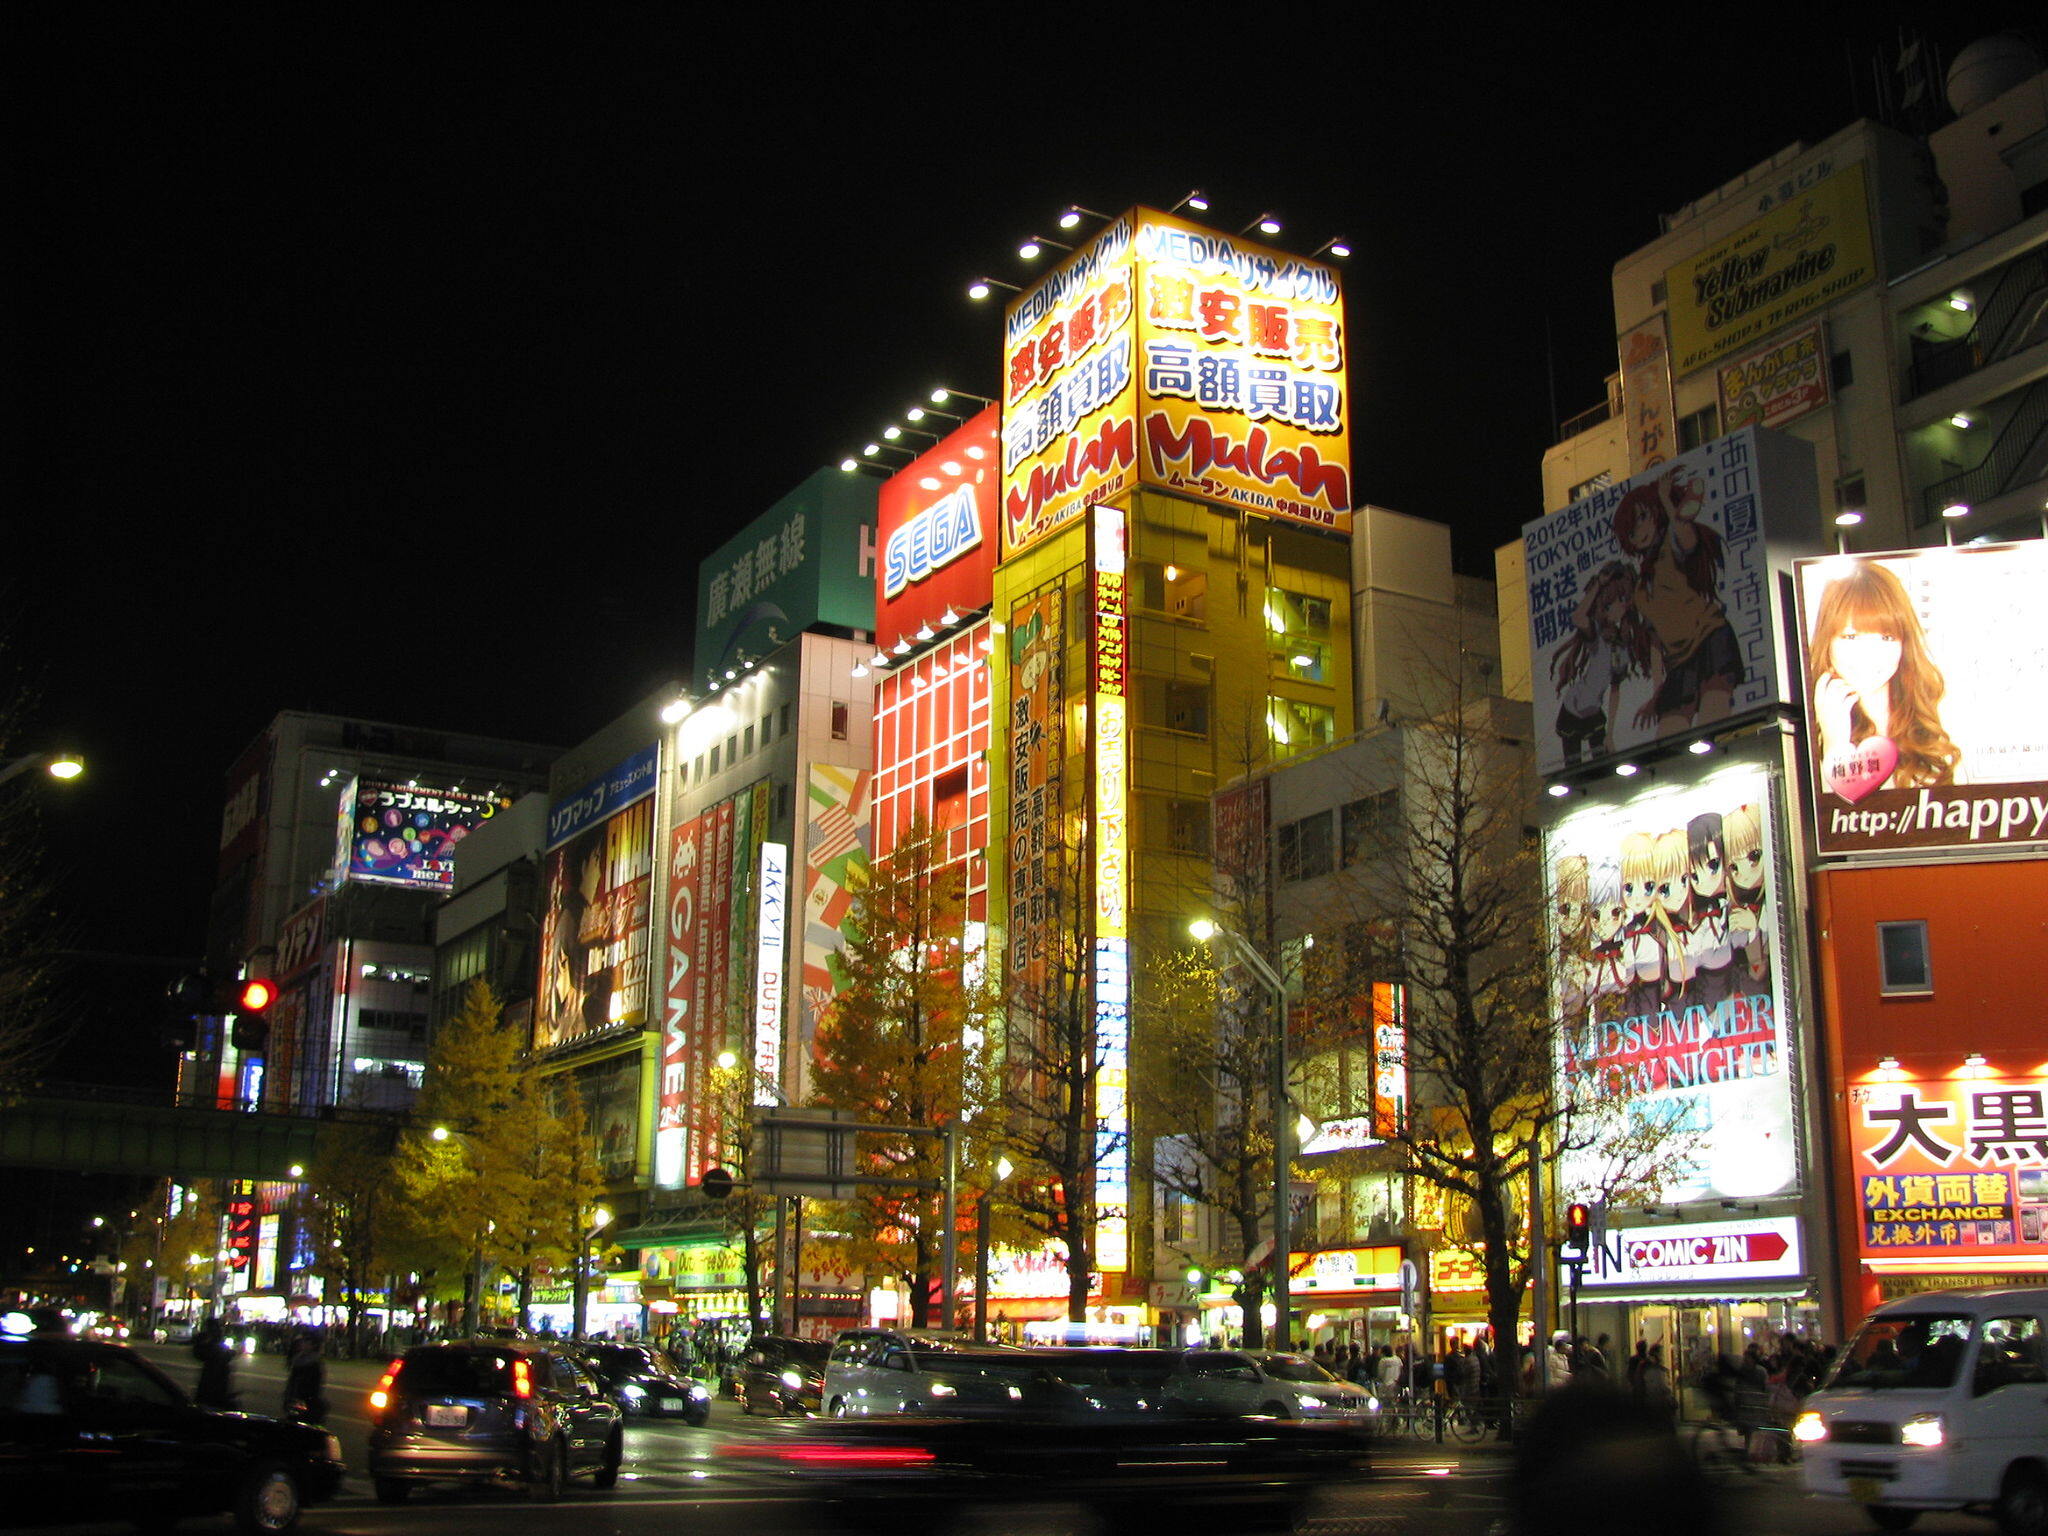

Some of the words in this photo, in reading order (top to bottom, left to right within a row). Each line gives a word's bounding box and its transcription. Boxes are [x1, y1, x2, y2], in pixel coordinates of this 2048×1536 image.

[1693, 246, 1769, 303] Yellow
[1708, 243, 1836, 330] Submarine
[1010, 279, 1129, 400] 激安販売
[1149, 271, 1336, 366] 激安販売
[1007, 340, 1127, 470] 高額買取
[1147, 344, 1337, 428] 高額買取
[1006, 419, 1135, 546] Mulan
[1145, 412, 1349, 511] Mulan
[1168, 472, 1229, 496] ムーラン
[1231, 487, 1274, 508] AKIBA
[885, 486, 979, 595] SEGA
[1017, 514, 1054, 546] ムーラン
[1054, 500, 1082, 526] AKIBA
[1526, 478, 1631, 552] 2012年1月より
[1528, 531, 1585, 575] TOKYO
[1586, 514, 1614, 544] MX
[1098, 572, 1122, 589] DVD
[1530, 563, 1578, 615] 放送
[1534, 600, 1577, 649] 開始
[379, 790, 474, 815] ラブメルシー
[551, 781, 607, 838] ソフマップ
[1830, 790, 2048, 841] http://happy
[604, 800, 651, 894] FINAL
[1011, 695, 1032, 974] 激安販売の専門店
[764, 856, 784, 928] AKKY
[623, 981, 646, 1014] SALE
[663, 886, 693, 1096] GAME
[762, 971, 779, 1032] DUTY
[1565, 994, 1776, 1063] MIDSUMMER
[1666, 1039, 1778, 1090] NIGHT
[1868, 1089, 2048, 1166] 大黒
[1864, 1173, 2009, 1208] 外貨両替
[1872, 1206, 2004, 1223] EXCHANGE
[1629, 1233, 1709, 1268] COMIC
[1712, 1234, 1748, 1264] ZIN
[1882, 1277, 1922, 1288] MONEY
[1927, 1276, 1985, 1288] TRANSFER
